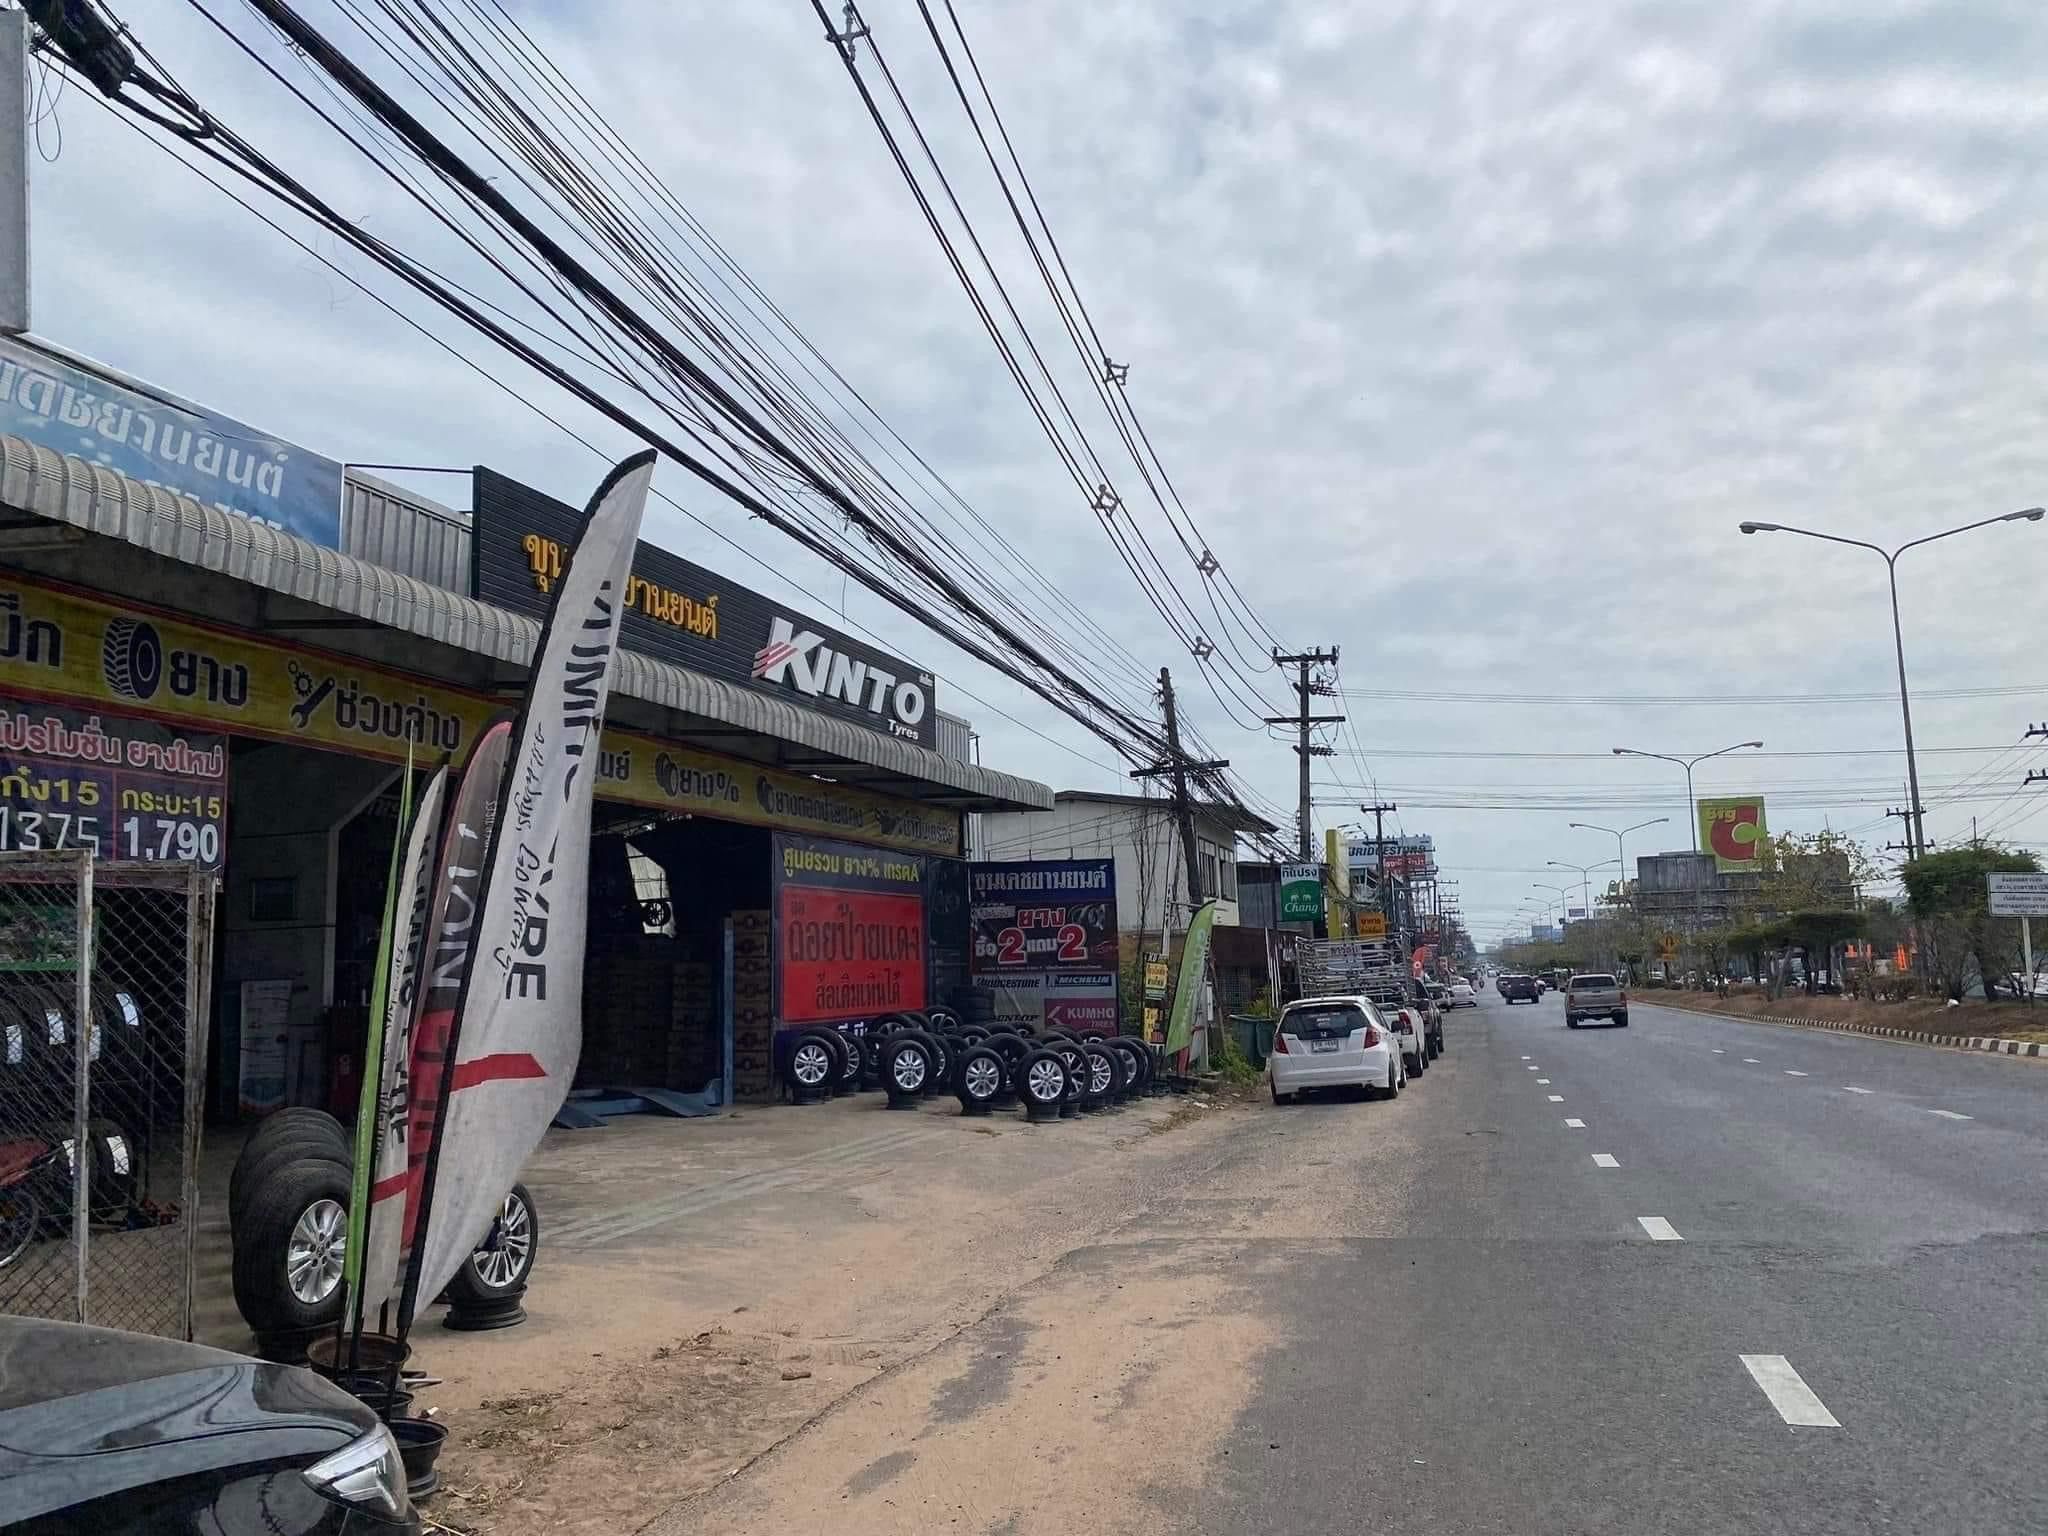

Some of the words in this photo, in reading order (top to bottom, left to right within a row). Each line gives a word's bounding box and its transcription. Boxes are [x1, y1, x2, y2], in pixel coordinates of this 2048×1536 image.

[0, 362, 288, 498] เดชยานยนต์
[170, 649, 249, 707] ยาง
[751, 616, 926, 725] KINTO
[335, 679, 462, 751] ช่วงล่าง
[887, 718, 919, 740] Tyres
[0, 765, 100, 806] ก๋ง15
[1707, 807, 1736, 823] Big
[1710, 805, 1760, 863] C
[123, 816, 219, 863] 1,790
[1017, 908, 1066, 928] ยาง
[1284, 902, 1319, 914] Chang
[997, 928, 1026, 964] 2
[1058, 924, 1088, 961] 2
[1058, 975, 1110, 984] MICHELIN
[1066, 1007, 1115, 1019] KUMHO
